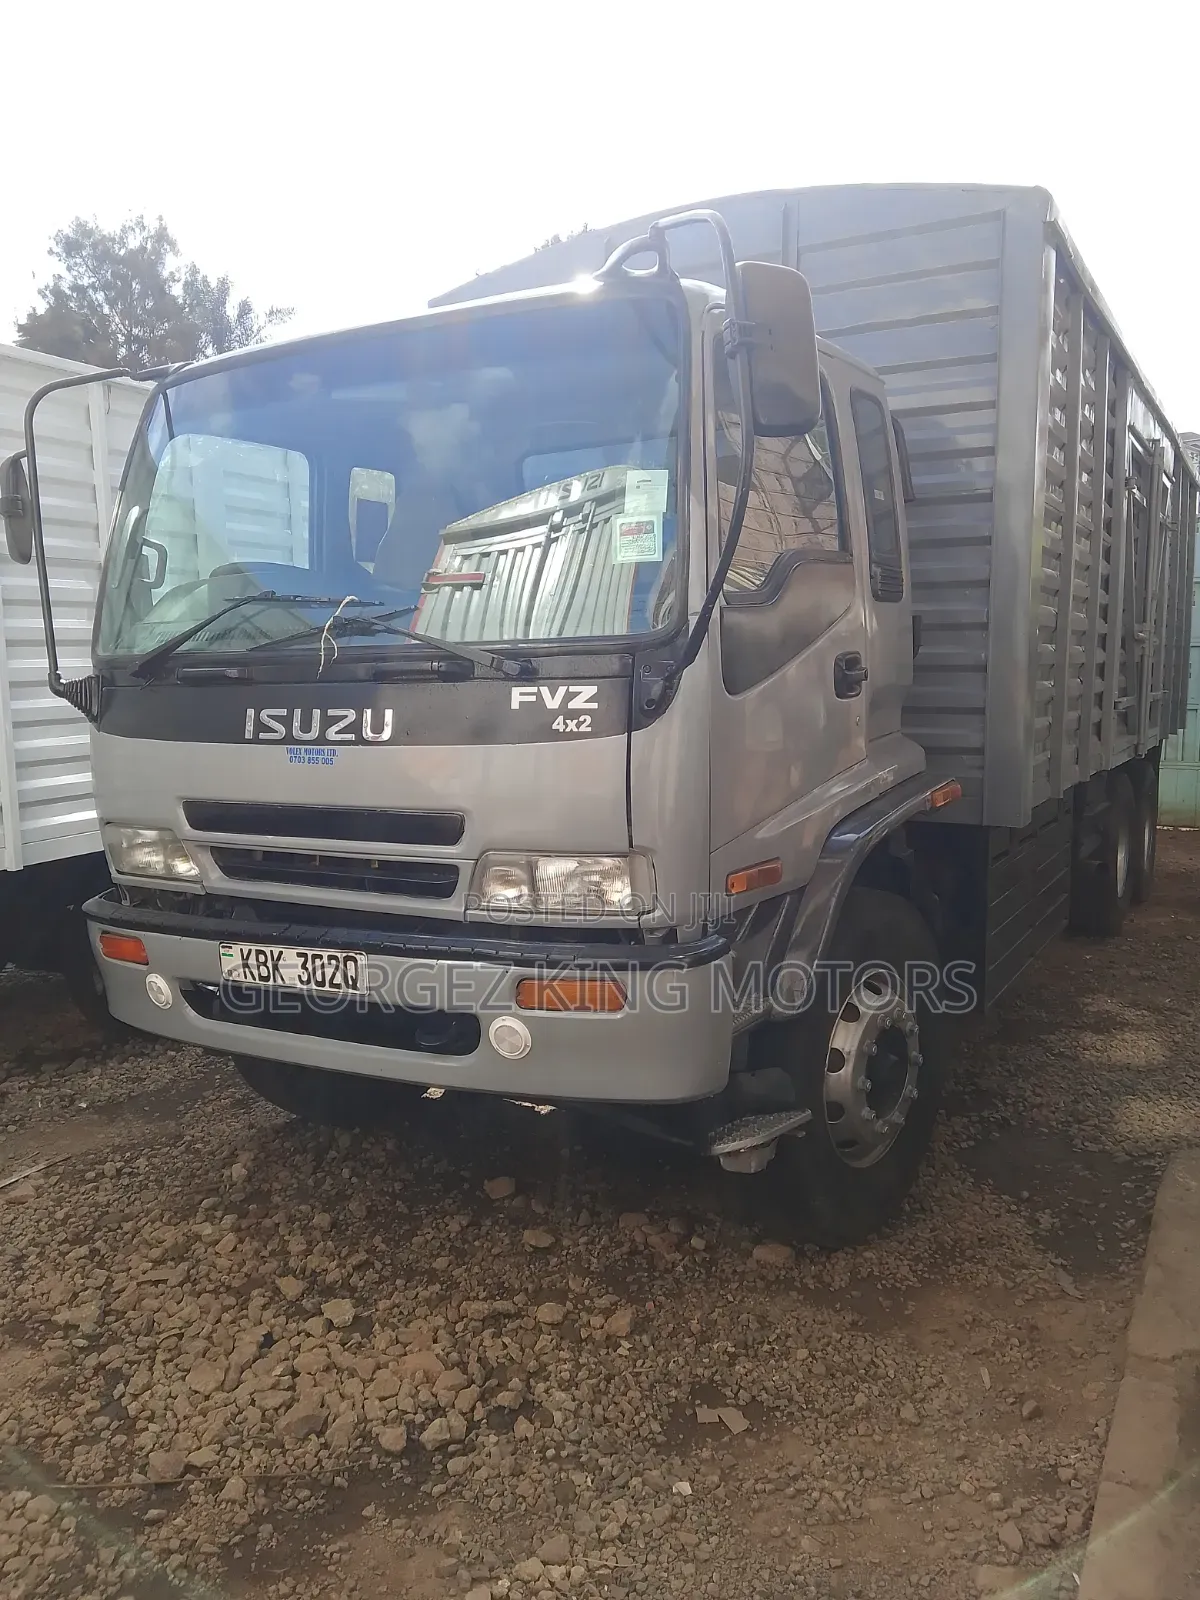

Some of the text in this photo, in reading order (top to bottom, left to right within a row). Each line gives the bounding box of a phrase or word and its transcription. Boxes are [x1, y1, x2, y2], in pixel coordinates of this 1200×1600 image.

[510, 685, 599, 710] FVZ
[244, 708, 394, 742] ISUZU
[551, 715, 592, 733] 4x2
[289, 756, 334, 766] 0703 855 005
[304, 747, 326, 757] MOTORS
[239, 948, 361, 992] KBK 302Q
